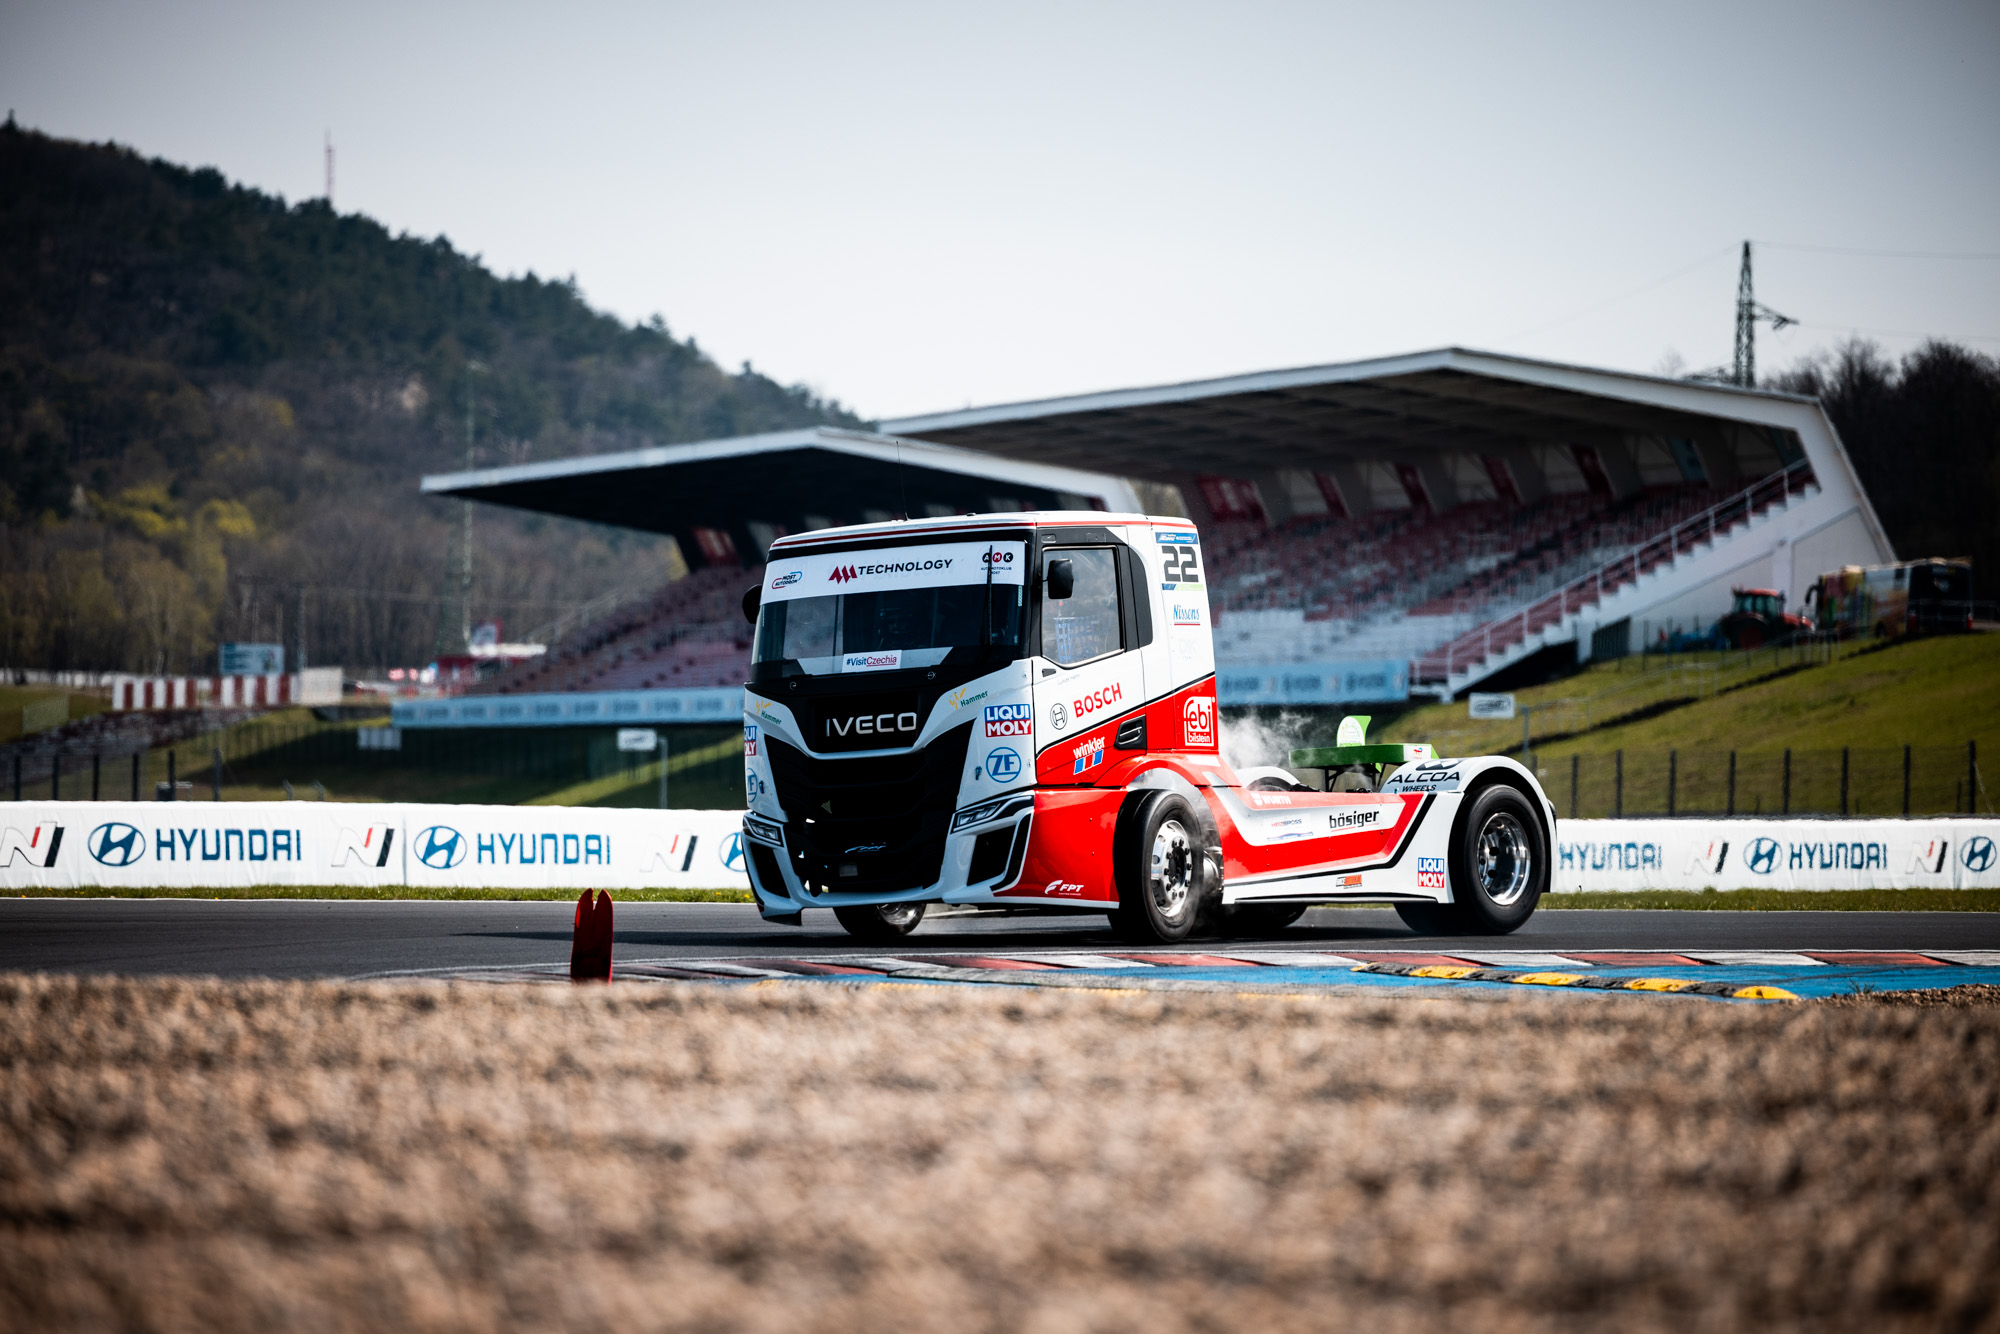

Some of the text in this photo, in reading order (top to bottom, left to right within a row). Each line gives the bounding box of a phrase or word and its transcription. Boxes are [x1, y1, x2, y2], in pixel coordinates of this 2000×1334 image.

[983, 553, 1012, 562] AMK
[1161, 545, 1199, 583] 22
[858, 558, 953, 576] TECHNOLOGY
[1173, 604, 1200, 620] Nissens
[846, 655, 897, 667] #VisitCzechia
[960, 690, 989, 707] Hammer
[1073, 682, 1122, 718] BOSCH
[761, 710, 782, 725] Hammer
[985, 705, 1030, 721] LIQUI
[826, 712, 917, 737] IVECO
[987, 721, 1031, 737] MOLY
[1188, 732, 1211, 743] bilstein
[1073, 736, 1105, 759] winkler
[988, 753, 1019, 777] ZF
[1387, 771, 1460, 785] ALCOA
[1402, 784, 1437, 792] WHEELS
[1329, 810, 1380, 829] bösiger
[156, 828, 302, 861] HYUNDAI
[477, 833, 611, 865] HYUNDAI
[1559, 841, 1663, 871] HYUNDAI
[1789, 841, 1888, 870] HYUNDAI
[1418, 858, 1444, 872] LIQUI
[1059, 883, 1085, 892] FPT
[1418, 872, 1444, 887] MOLY
